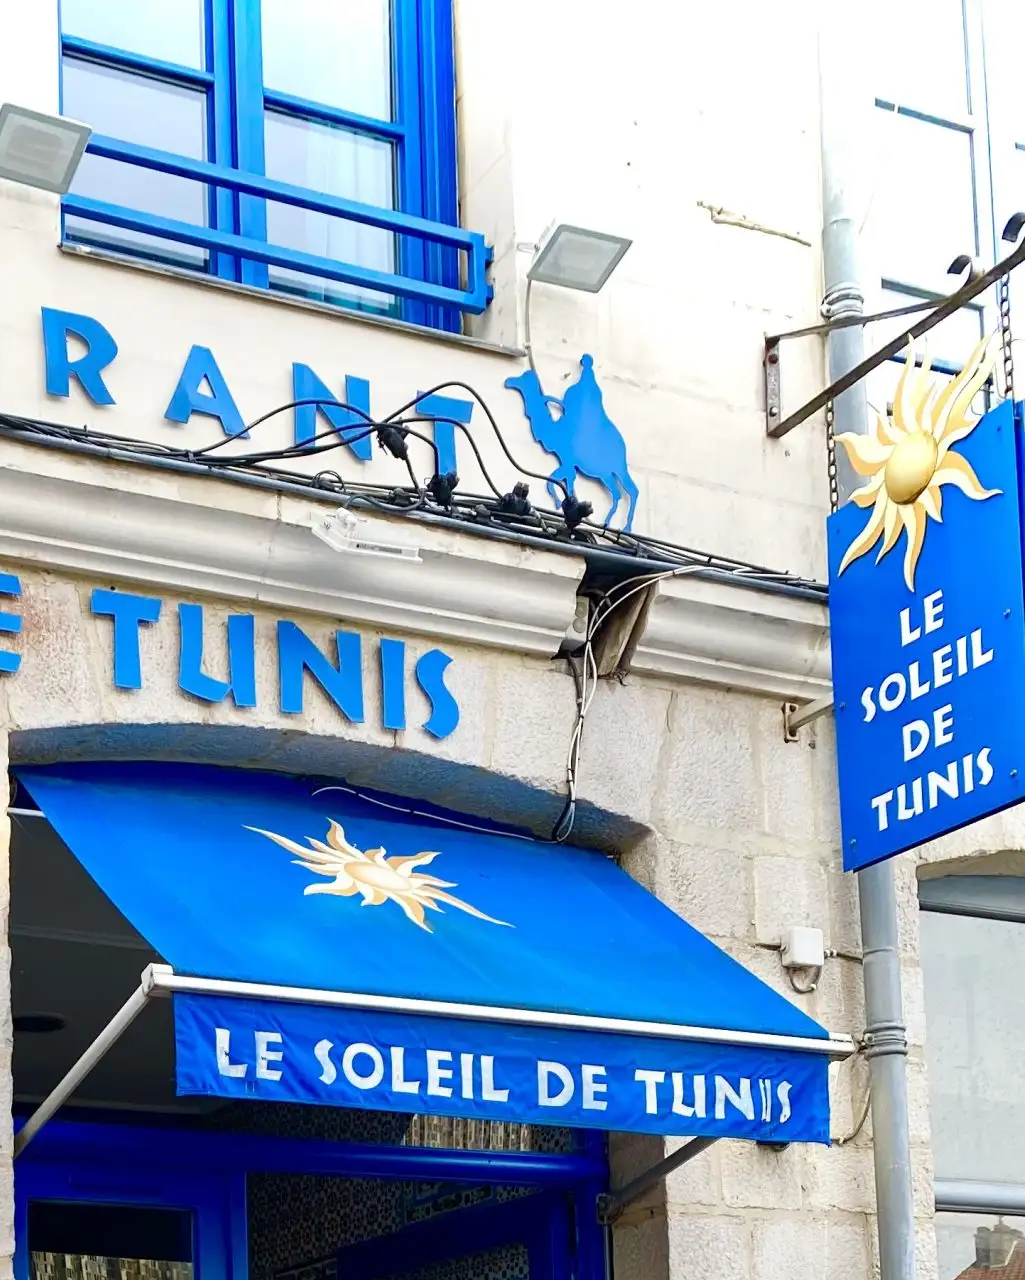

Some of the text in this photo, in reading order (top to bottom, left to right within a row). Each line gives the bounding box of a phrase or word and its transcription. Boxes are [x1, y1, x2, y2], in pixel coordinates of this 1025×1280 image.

[90, 587, 461, 740] TUNIS
[899, 588, 944, 648] LE
[860, 627, 995, 723] SOLEIL
[902, 703, 955, 763] DE
[870, 746, 995, 832] TUNIS
[215, 1026, 793, 1124] LE SOLEIL DE TUNIS
